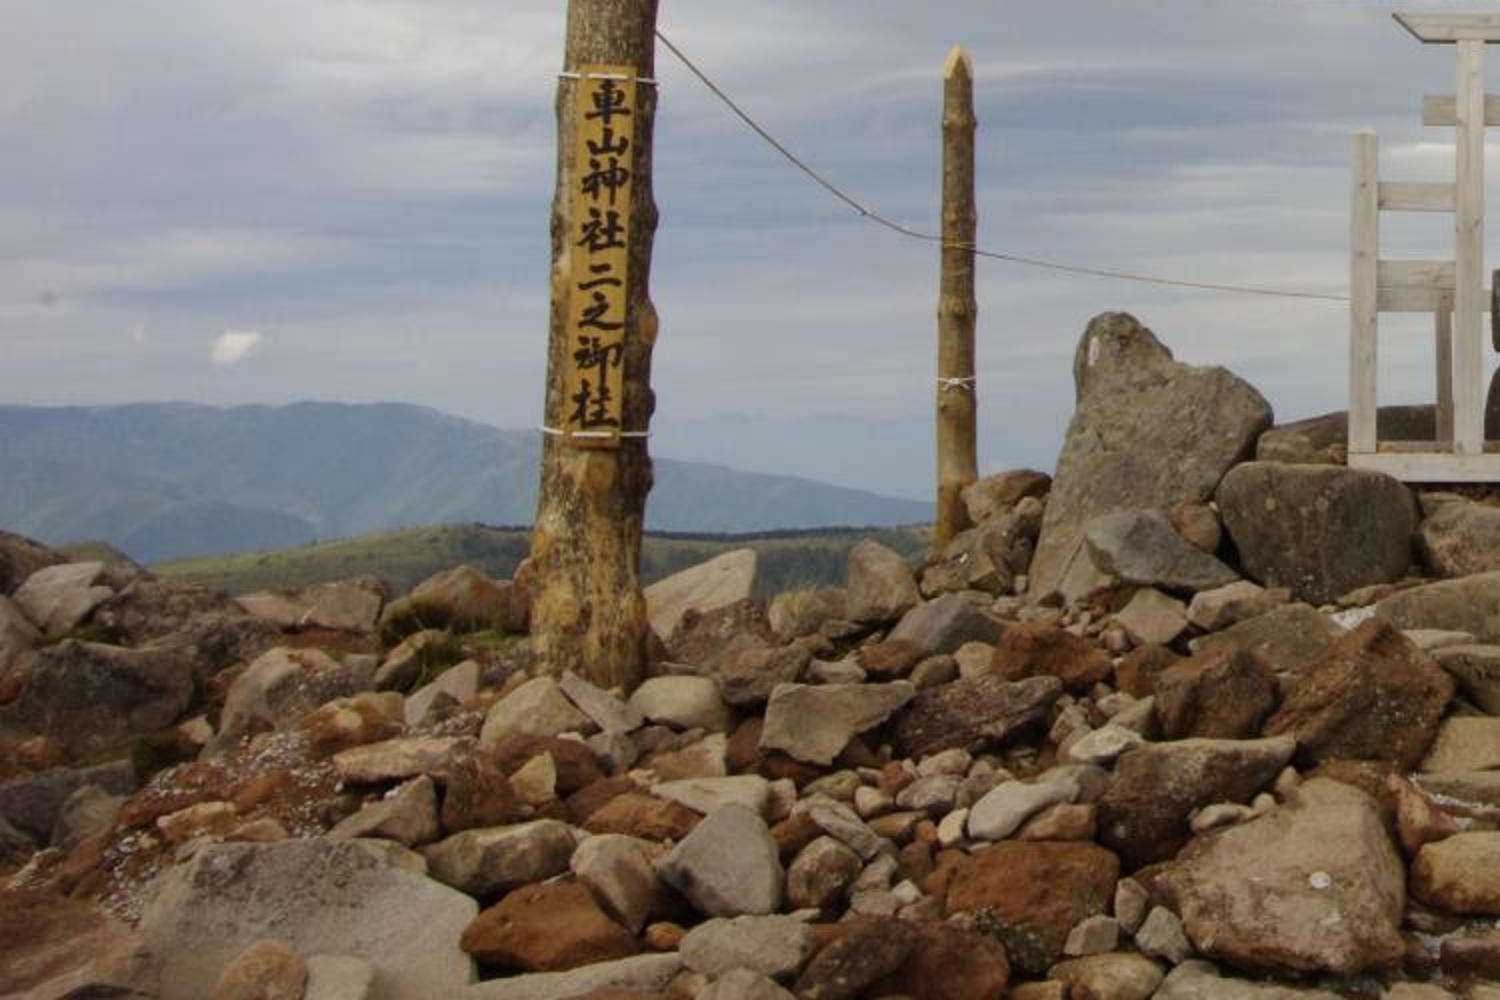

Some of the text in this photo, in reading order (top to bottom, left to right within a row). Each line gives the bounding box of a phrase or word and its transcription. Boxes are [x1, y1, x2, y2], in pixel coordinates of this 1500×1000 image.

[569, 78, 631, 429] 車山神社二之御柱
